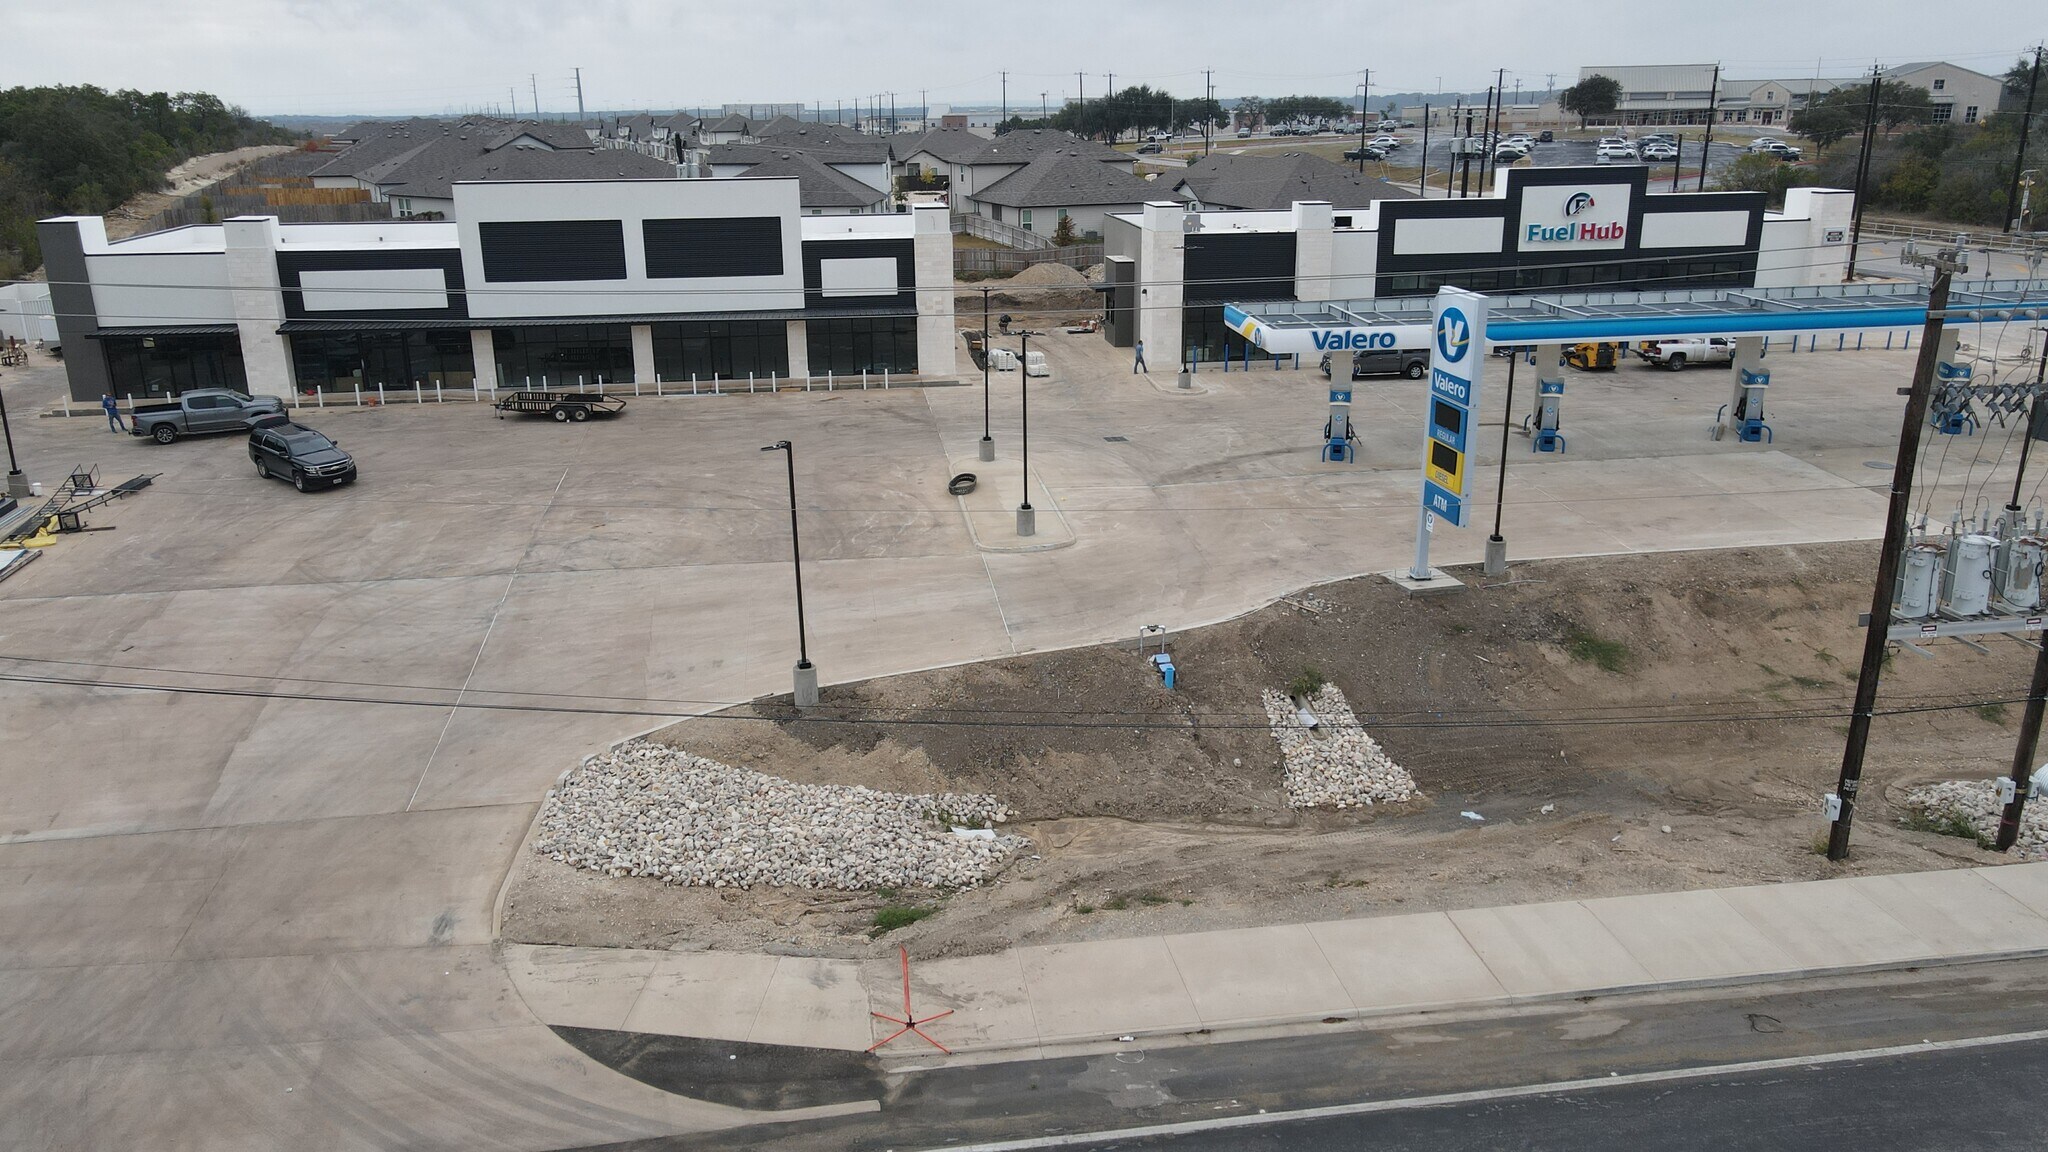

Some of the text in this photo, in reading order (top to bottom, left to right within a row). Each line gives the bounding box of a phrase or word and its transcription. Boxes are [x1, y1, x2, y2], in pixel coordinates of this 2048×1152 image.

[1527, 221, 1624, 242] Fuel Hub
[1311, 330, 1396, 350] Valero
[1434, 371, 1466, 399] Valero
[1432, 493, 1448, 513] ATM
